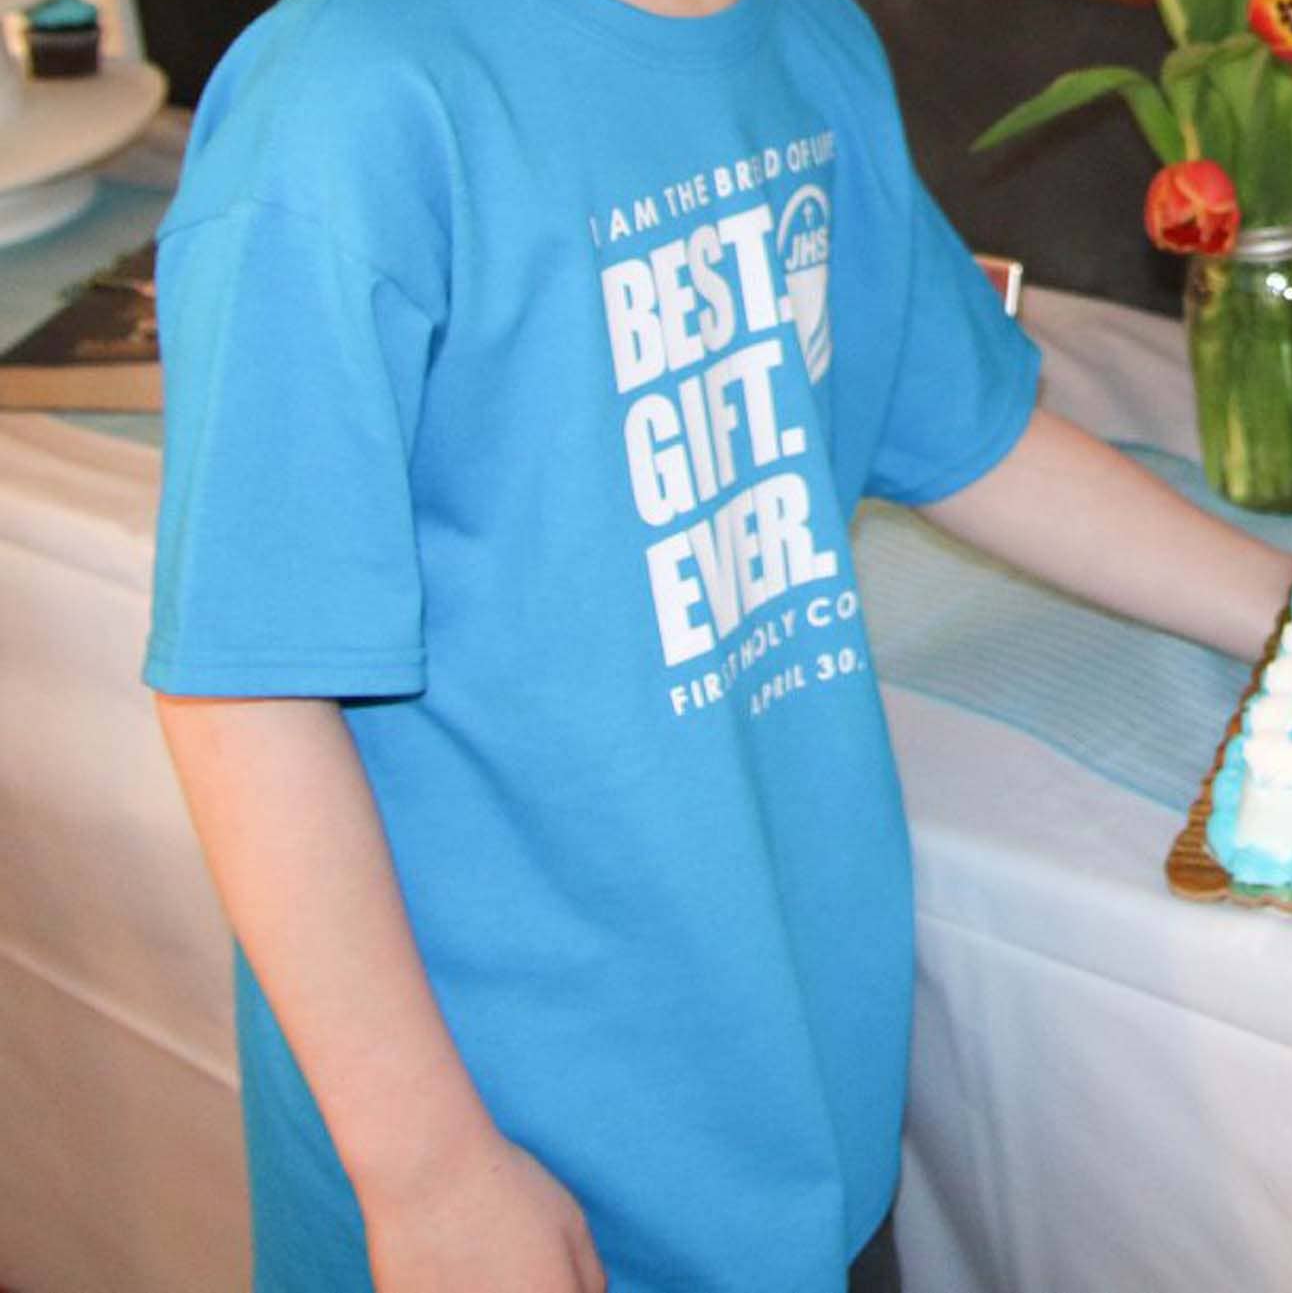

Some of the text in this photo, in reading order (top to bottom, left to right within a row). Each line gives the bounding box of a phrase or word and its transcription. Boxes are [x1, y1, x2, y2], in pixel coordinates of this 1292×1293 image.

[601, 204, 799, 395] BEST.
[610, 196, 660, 243] AM
[663, 174, 711, 217] THE
[624, 339, 807, 527] GIFT.
[645, 472, 838, 668] EVER.
[751, 664, 806, 716] APRIL
